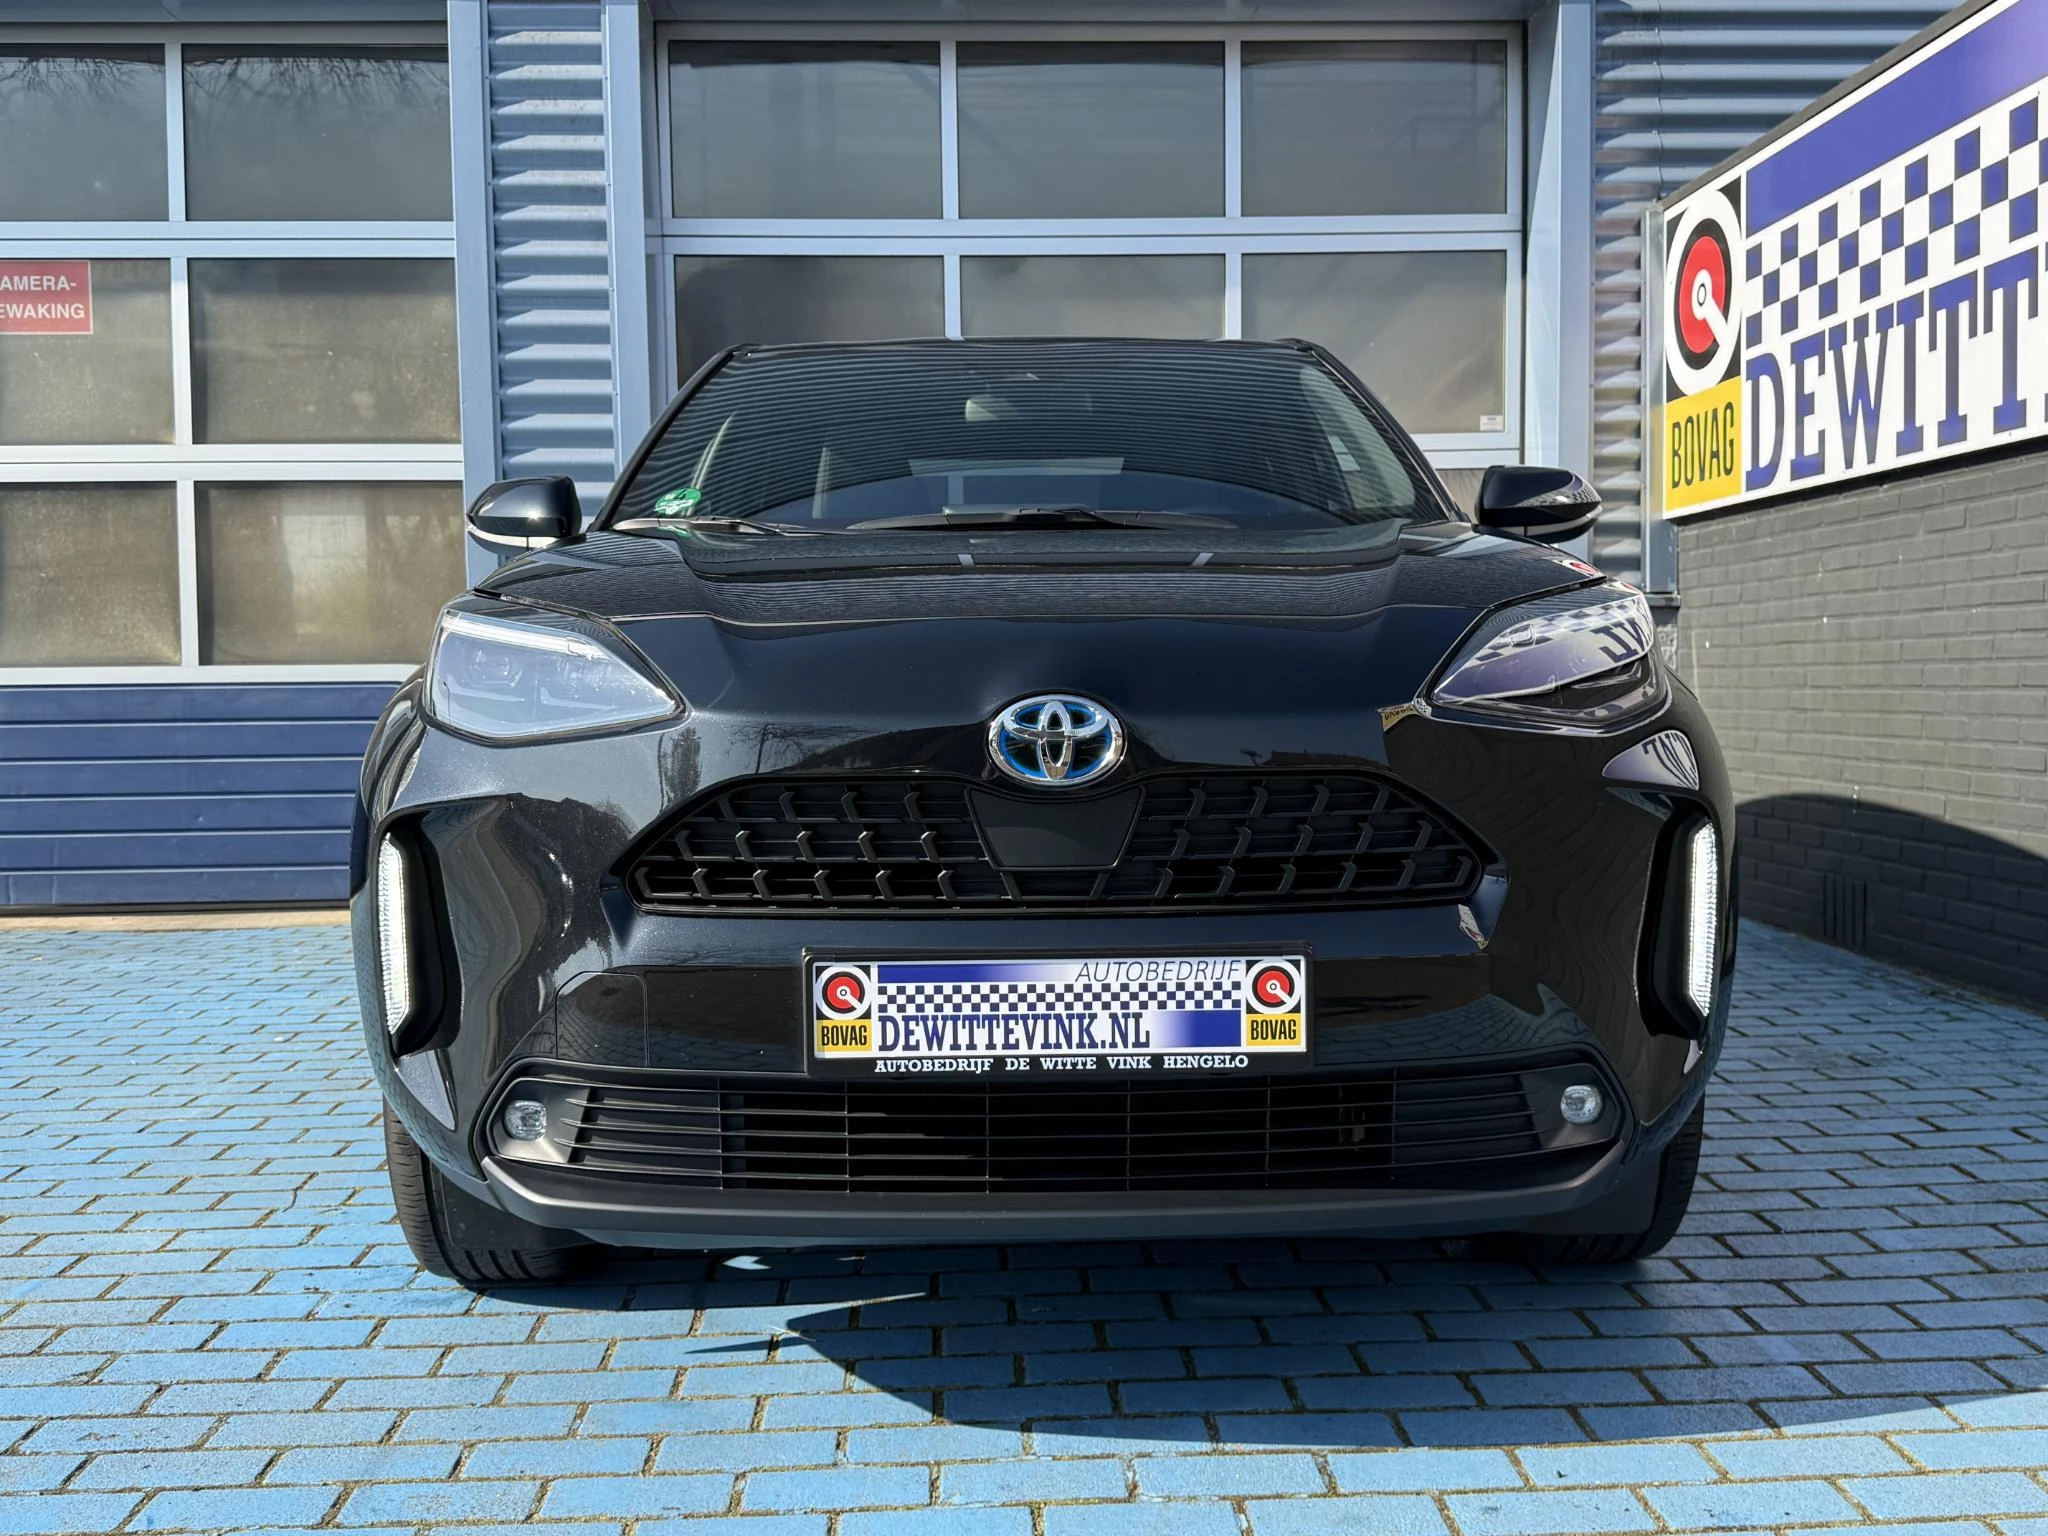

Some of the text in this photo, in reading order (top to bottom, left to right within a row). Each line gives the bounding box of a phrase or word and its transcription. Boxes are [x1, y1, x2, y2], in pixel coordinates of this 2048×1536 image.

[0, 275, 77, 291] AMERA-
[1746, 242, 2048, 492] DEWITT
[1671, 401, 1735, 490] BOVAG
[1075, 960, 1243, 982] AUTOBEDRIJF
[821, 1024, 868, 1047] BOVAG
[878, 1011, 1151, 1052] DEWITTEVINK.NL
[1250, 1018, 1297, 1041] BOVAG
[875, 1054, 1249, 1074] AUTOBEDRIJF DE WITTE VINK HENGELO
